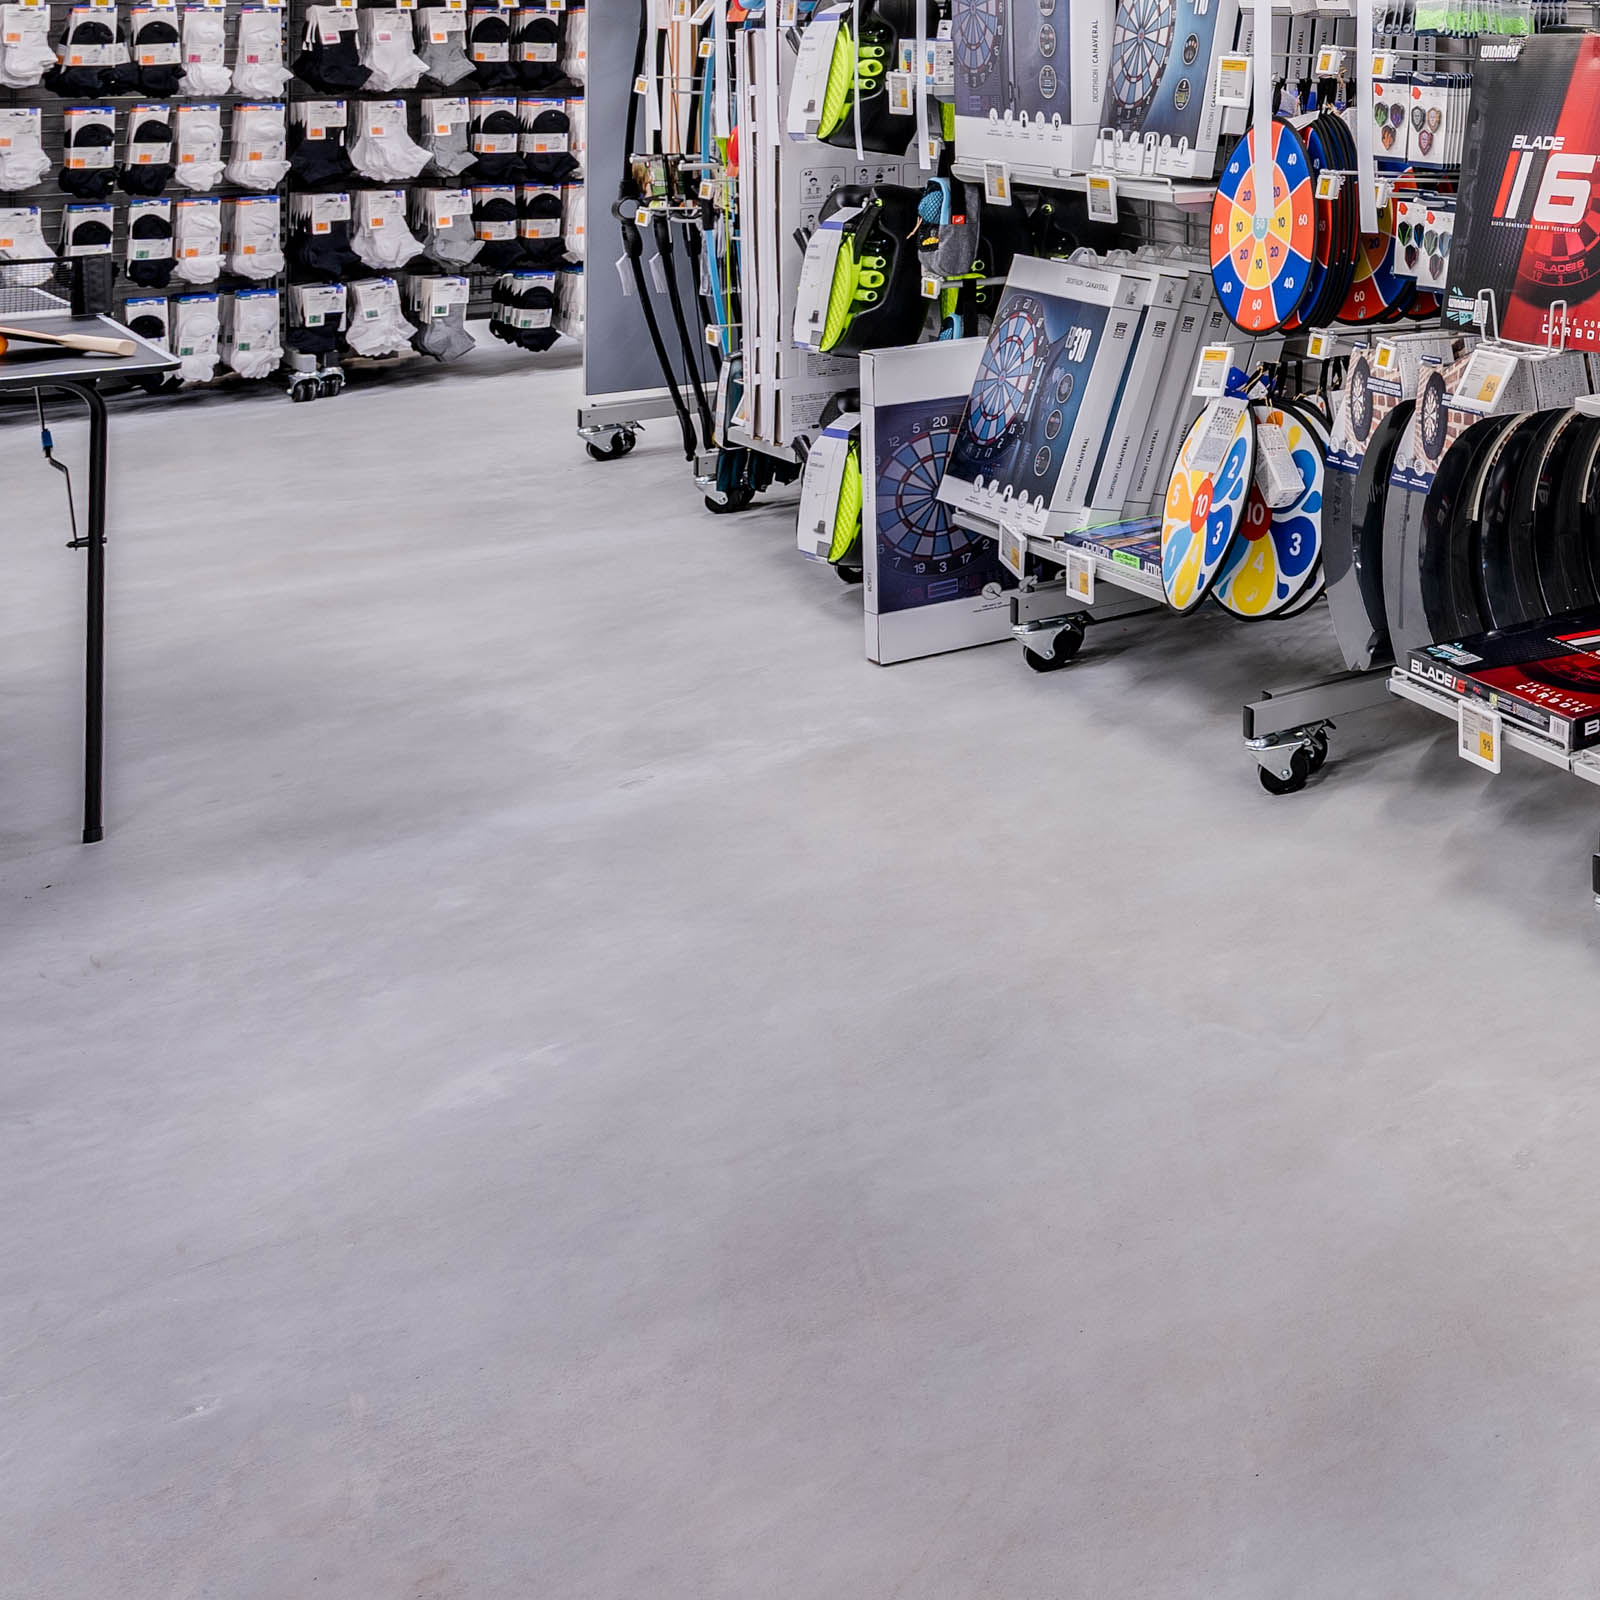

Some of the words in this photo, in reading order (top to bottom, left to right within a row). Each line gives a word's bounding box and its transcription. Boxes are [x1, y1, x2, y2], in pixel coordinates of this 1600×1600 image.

[1512, 134, 1566, 150] BLADE
[1228, 455, 1239, 479] 2
[1171, 486, 1180, 506] 5
[1212, 523, 1224, 544] 3
[1289, 532, 1302, 557] 3
[1252, 552, 1264, 573] 4
[1515, 684, 1584, 713] CARBON
